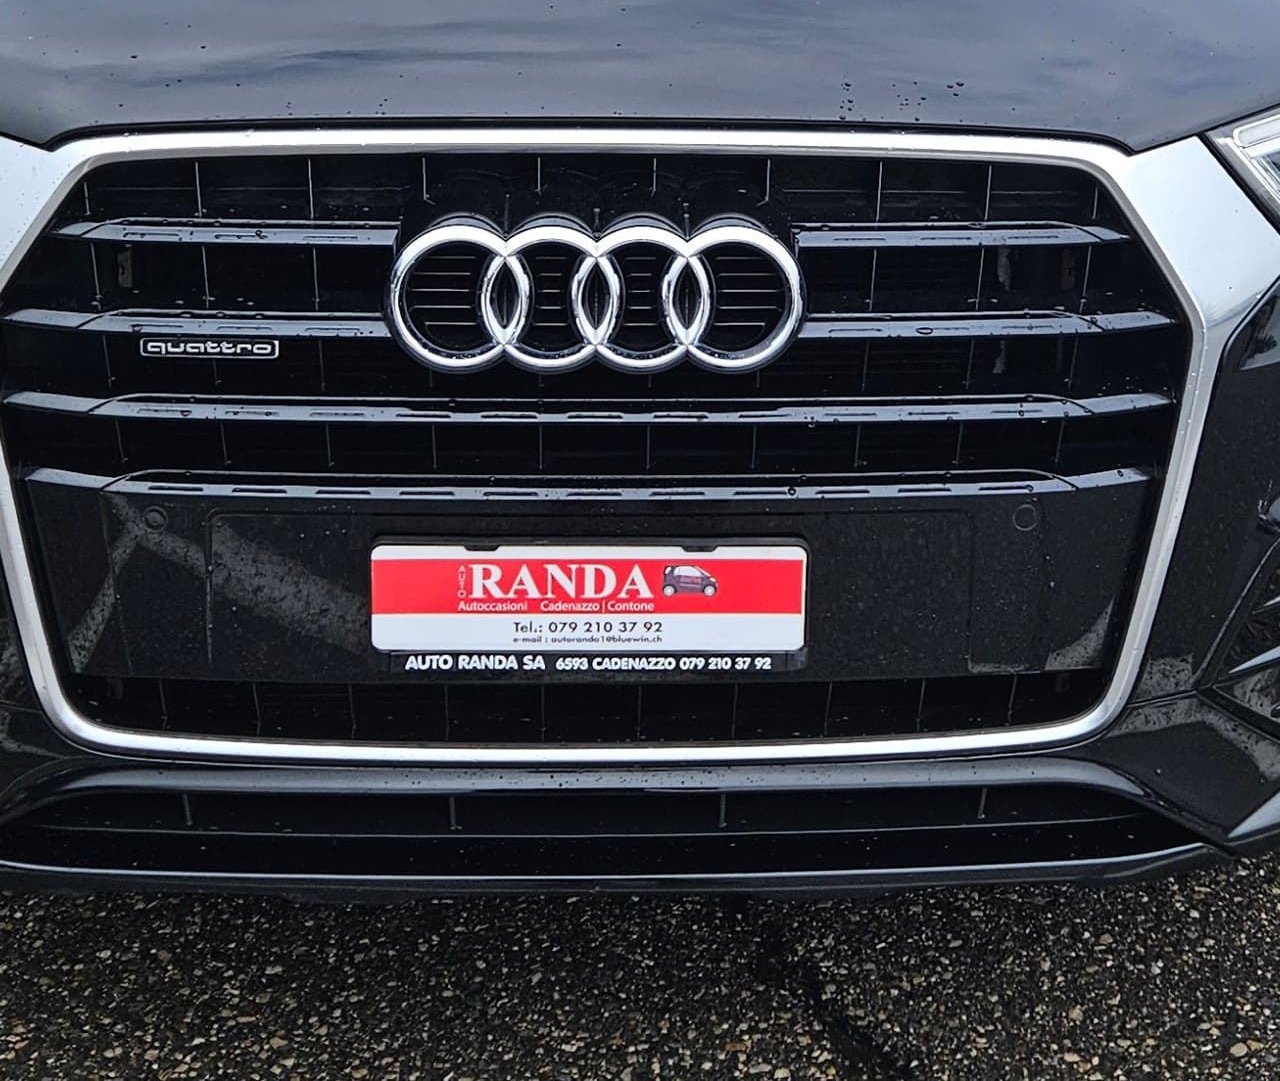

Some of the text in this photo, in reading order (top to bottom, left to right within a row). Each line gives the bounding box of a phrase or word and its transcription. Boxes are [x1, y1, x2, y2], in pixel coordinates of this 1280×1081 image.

[147, 340, 272, 355] quattro
[457, 565, 467, 598] AUTO
[468, 564, 655, 599] RANDA
[457, 600, 655, 612] Autoccasioni Cadenazzo Contone
[513, 621, 663, 633] Tel.: 079 210 37 92
[404, 655, 773, 671] AUTO RANDA SA 6593 CADENAZZO 079 210 37 92
